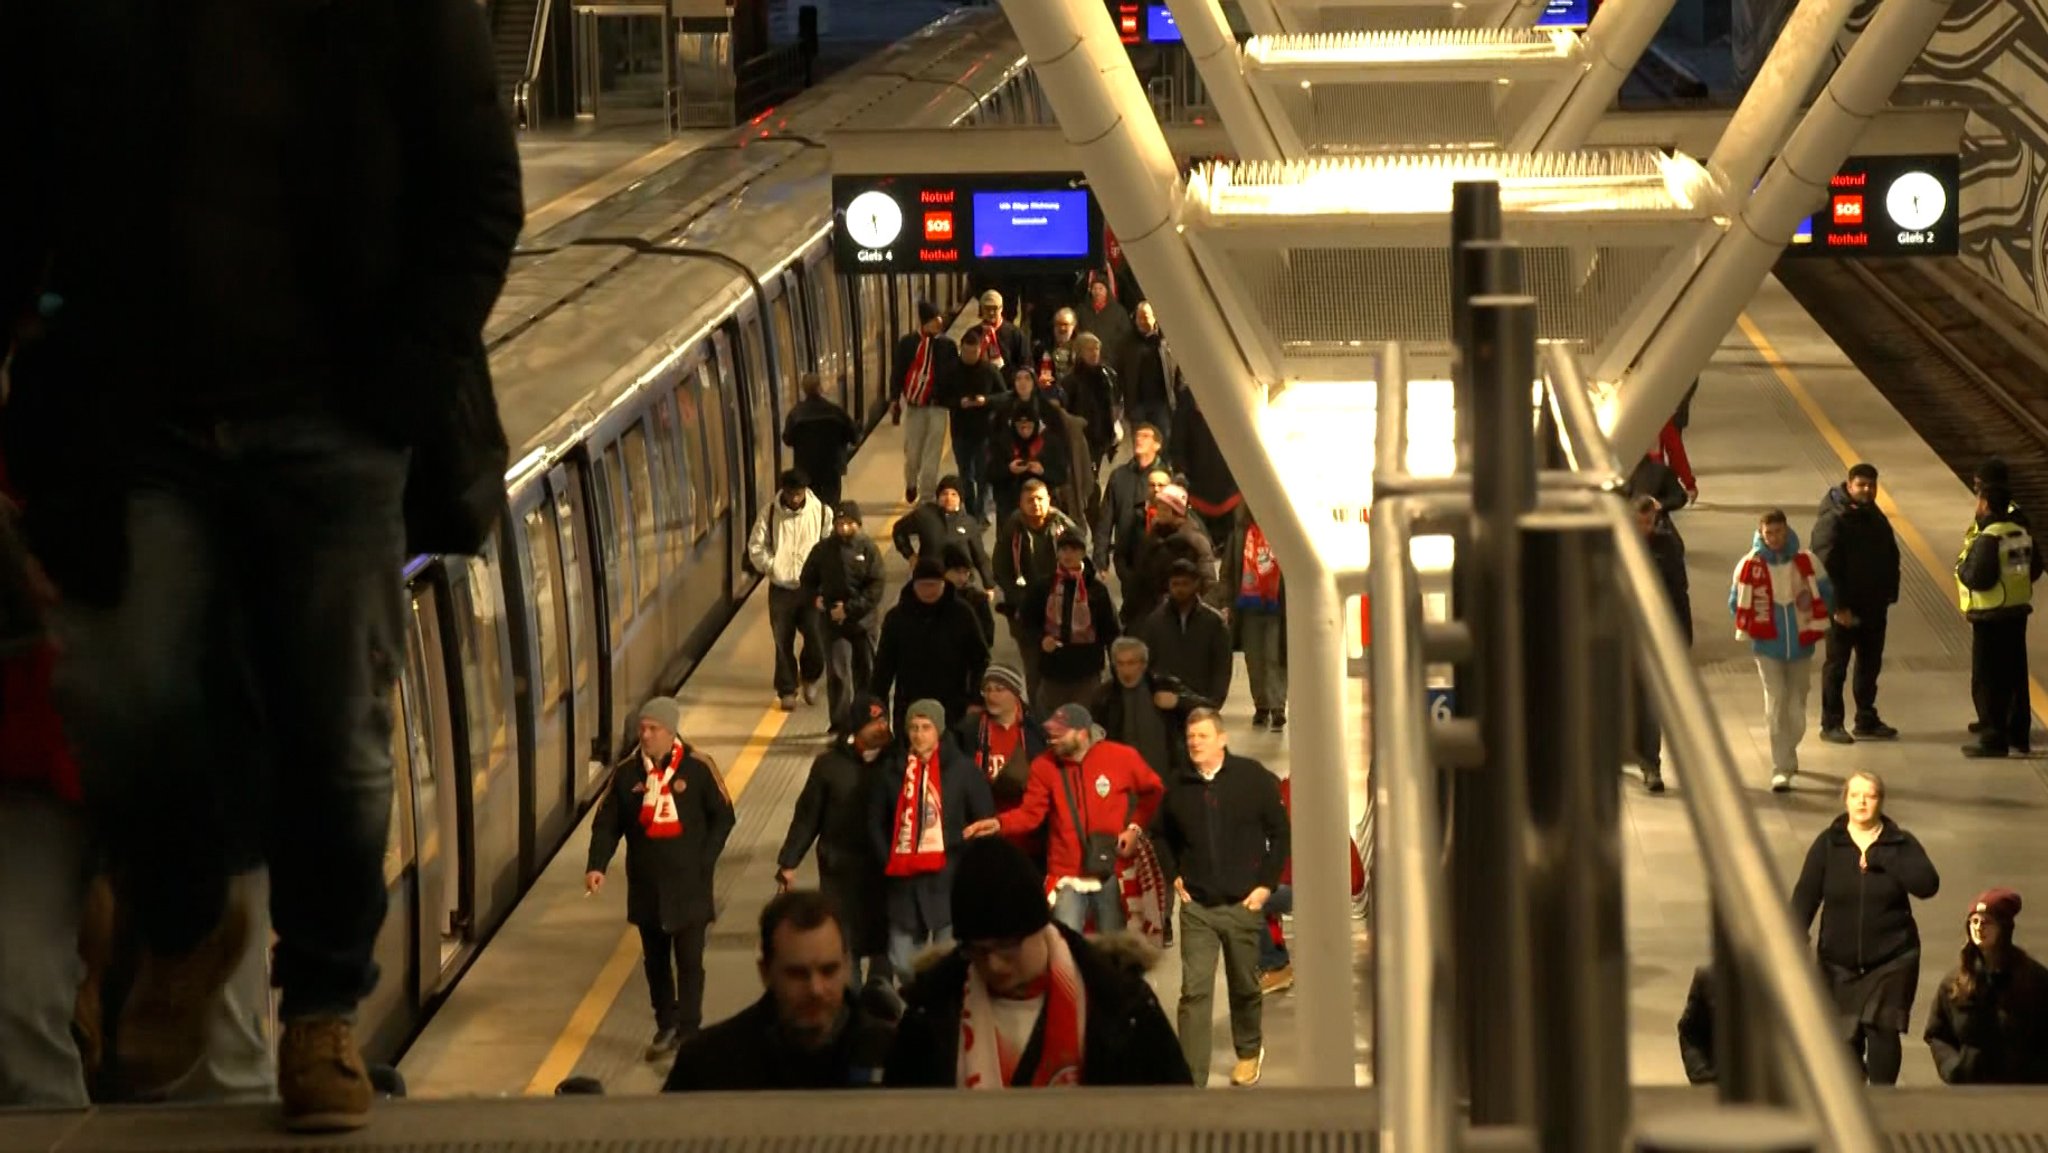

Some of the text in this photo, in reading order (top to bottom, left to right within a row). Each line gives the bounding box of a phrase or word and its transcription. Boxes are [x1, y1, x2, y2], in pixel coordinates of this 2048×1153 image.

[1831, 173, 1866, 187] Notruf
[921, 190, 954, 203] Notruf
[1836, 203, 1861, 216] SOS
[926, 220, 951, 232] SOS
[1828, 233, 1868, 246] Nothalt
[1897, 231, 1935, 244] Gleis 2
[857, 249, 893, 262] Gleis 4
[920, 249, 958, 260] Nothalt
[1431, 694, 1452, 724] 6
